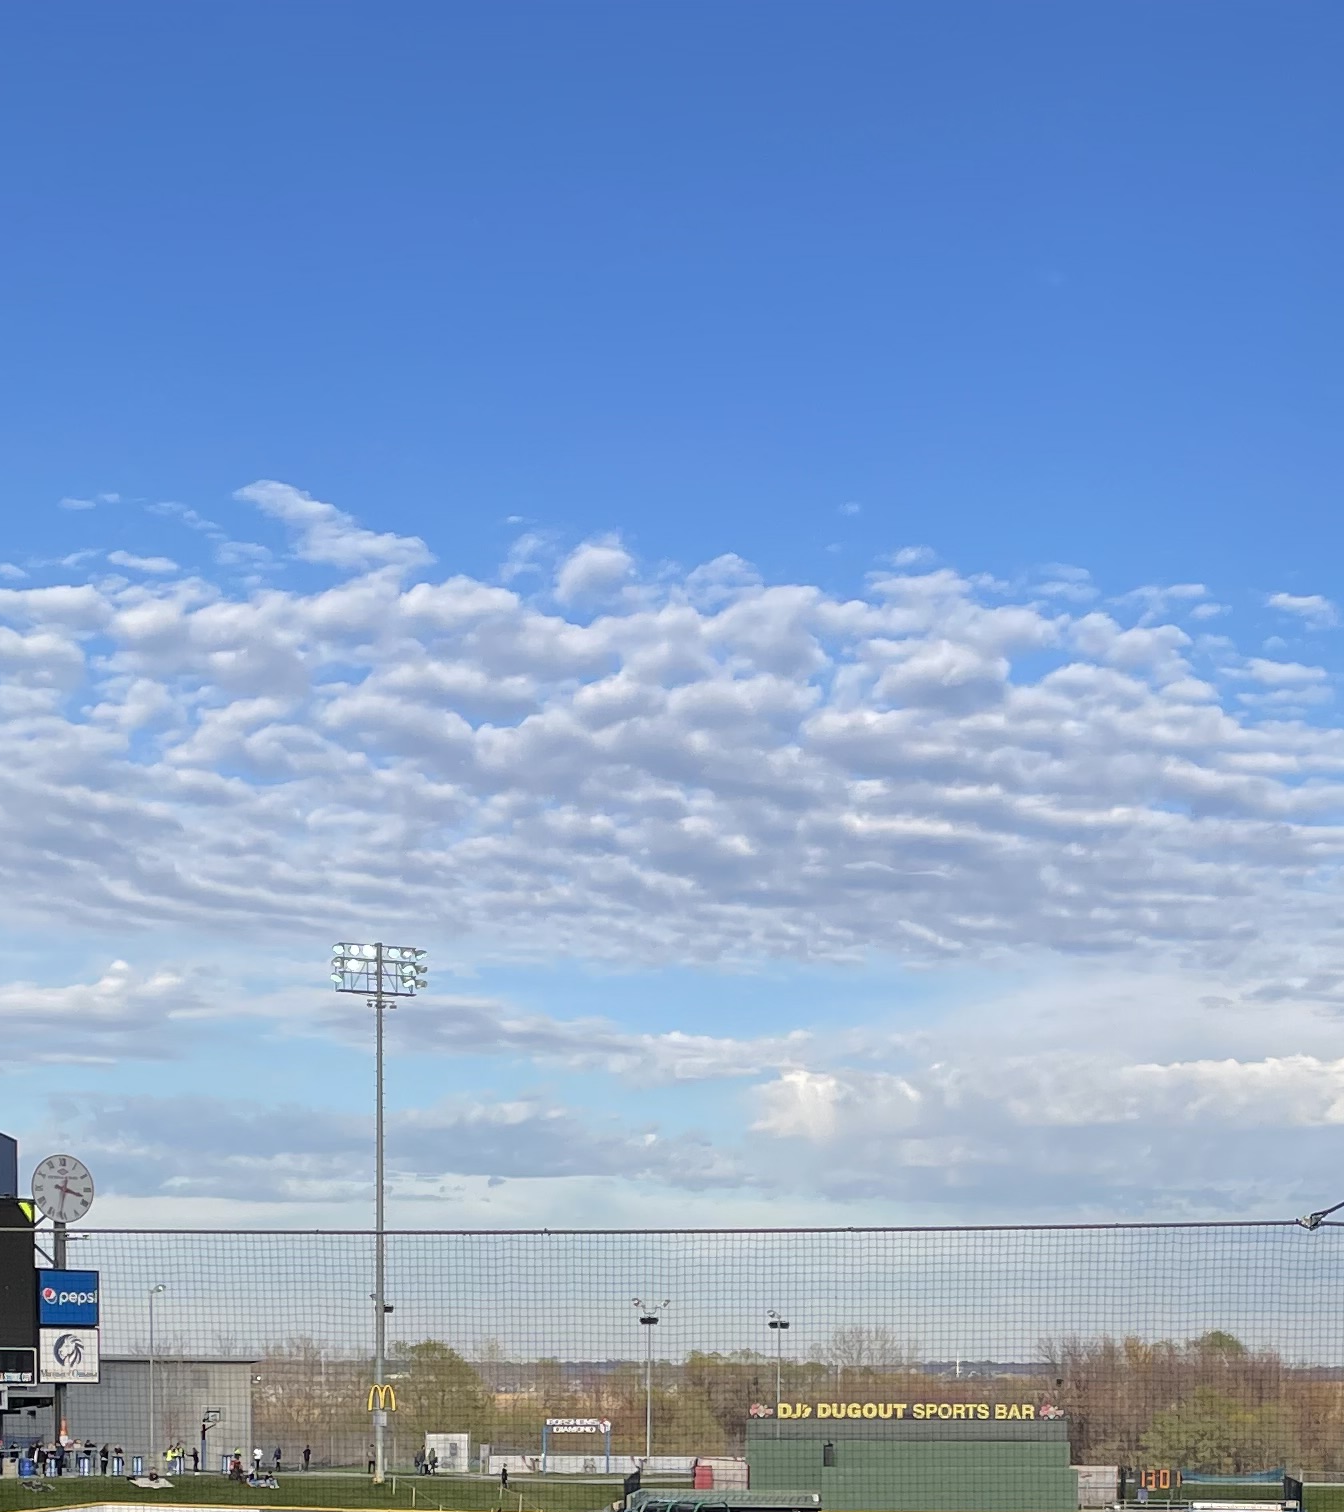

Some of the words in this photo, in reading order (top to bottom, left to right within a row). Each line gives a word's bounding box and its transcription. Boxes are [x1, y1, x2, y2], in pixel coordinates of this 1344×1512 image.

[58, 1289, 98, 1306] pepsi
[817, 1403, 907, 1419] DUGOUT
[912, 1403, 989, 1419] SPORTS
[994, 1403, 1035, 1420] BAR
